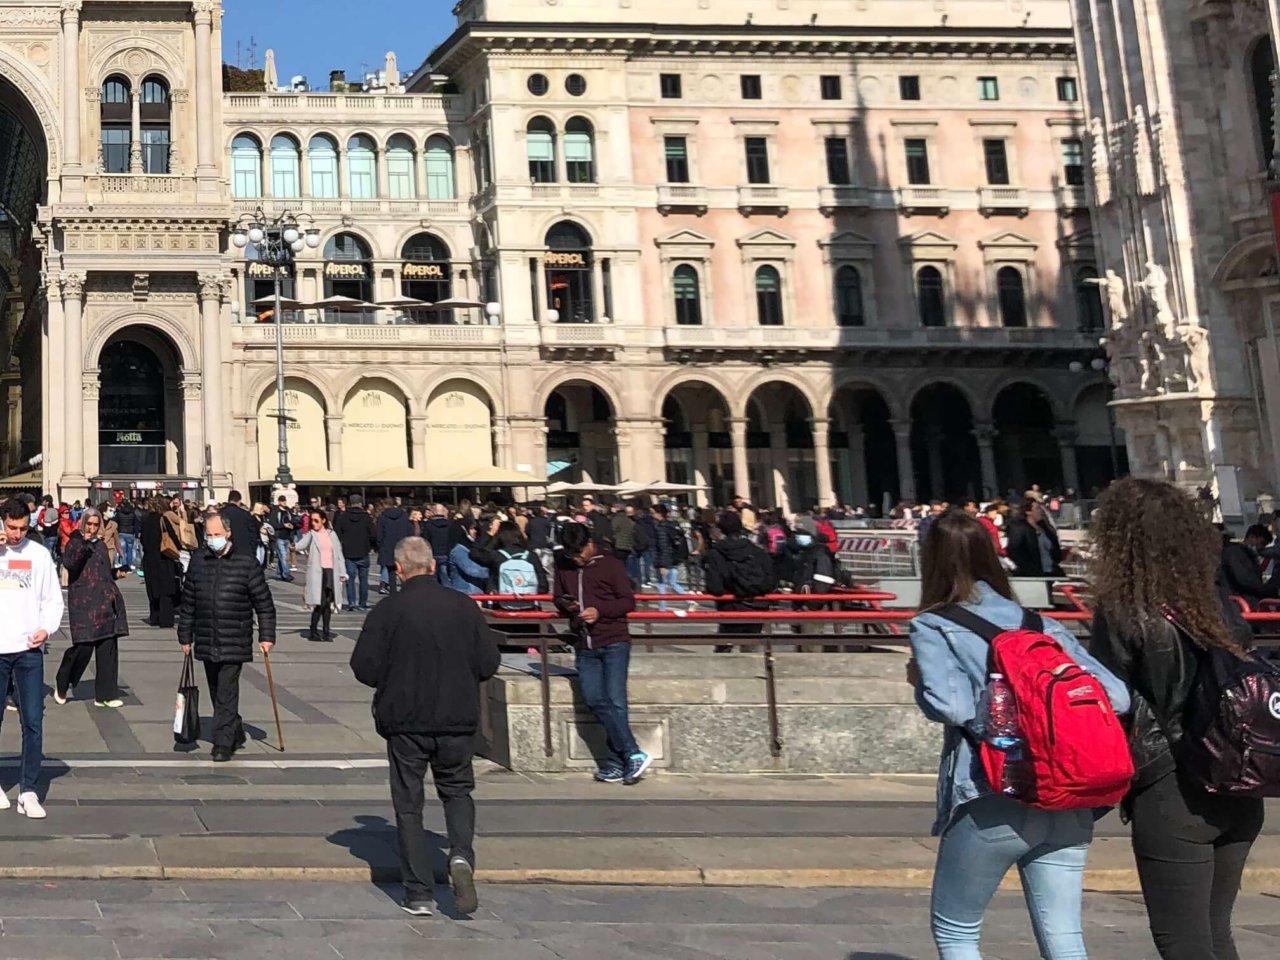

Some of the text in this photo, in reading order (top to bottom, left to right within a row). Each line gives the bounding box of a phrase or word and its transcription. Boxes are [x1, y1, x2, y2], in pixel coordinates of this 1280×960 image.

[545, 251, 585, 264] APEROL
[325, 262, 366, 275] APEROL
[403, 263, 443, 276] APEROL
[116, 432, 142, 442] Motta
